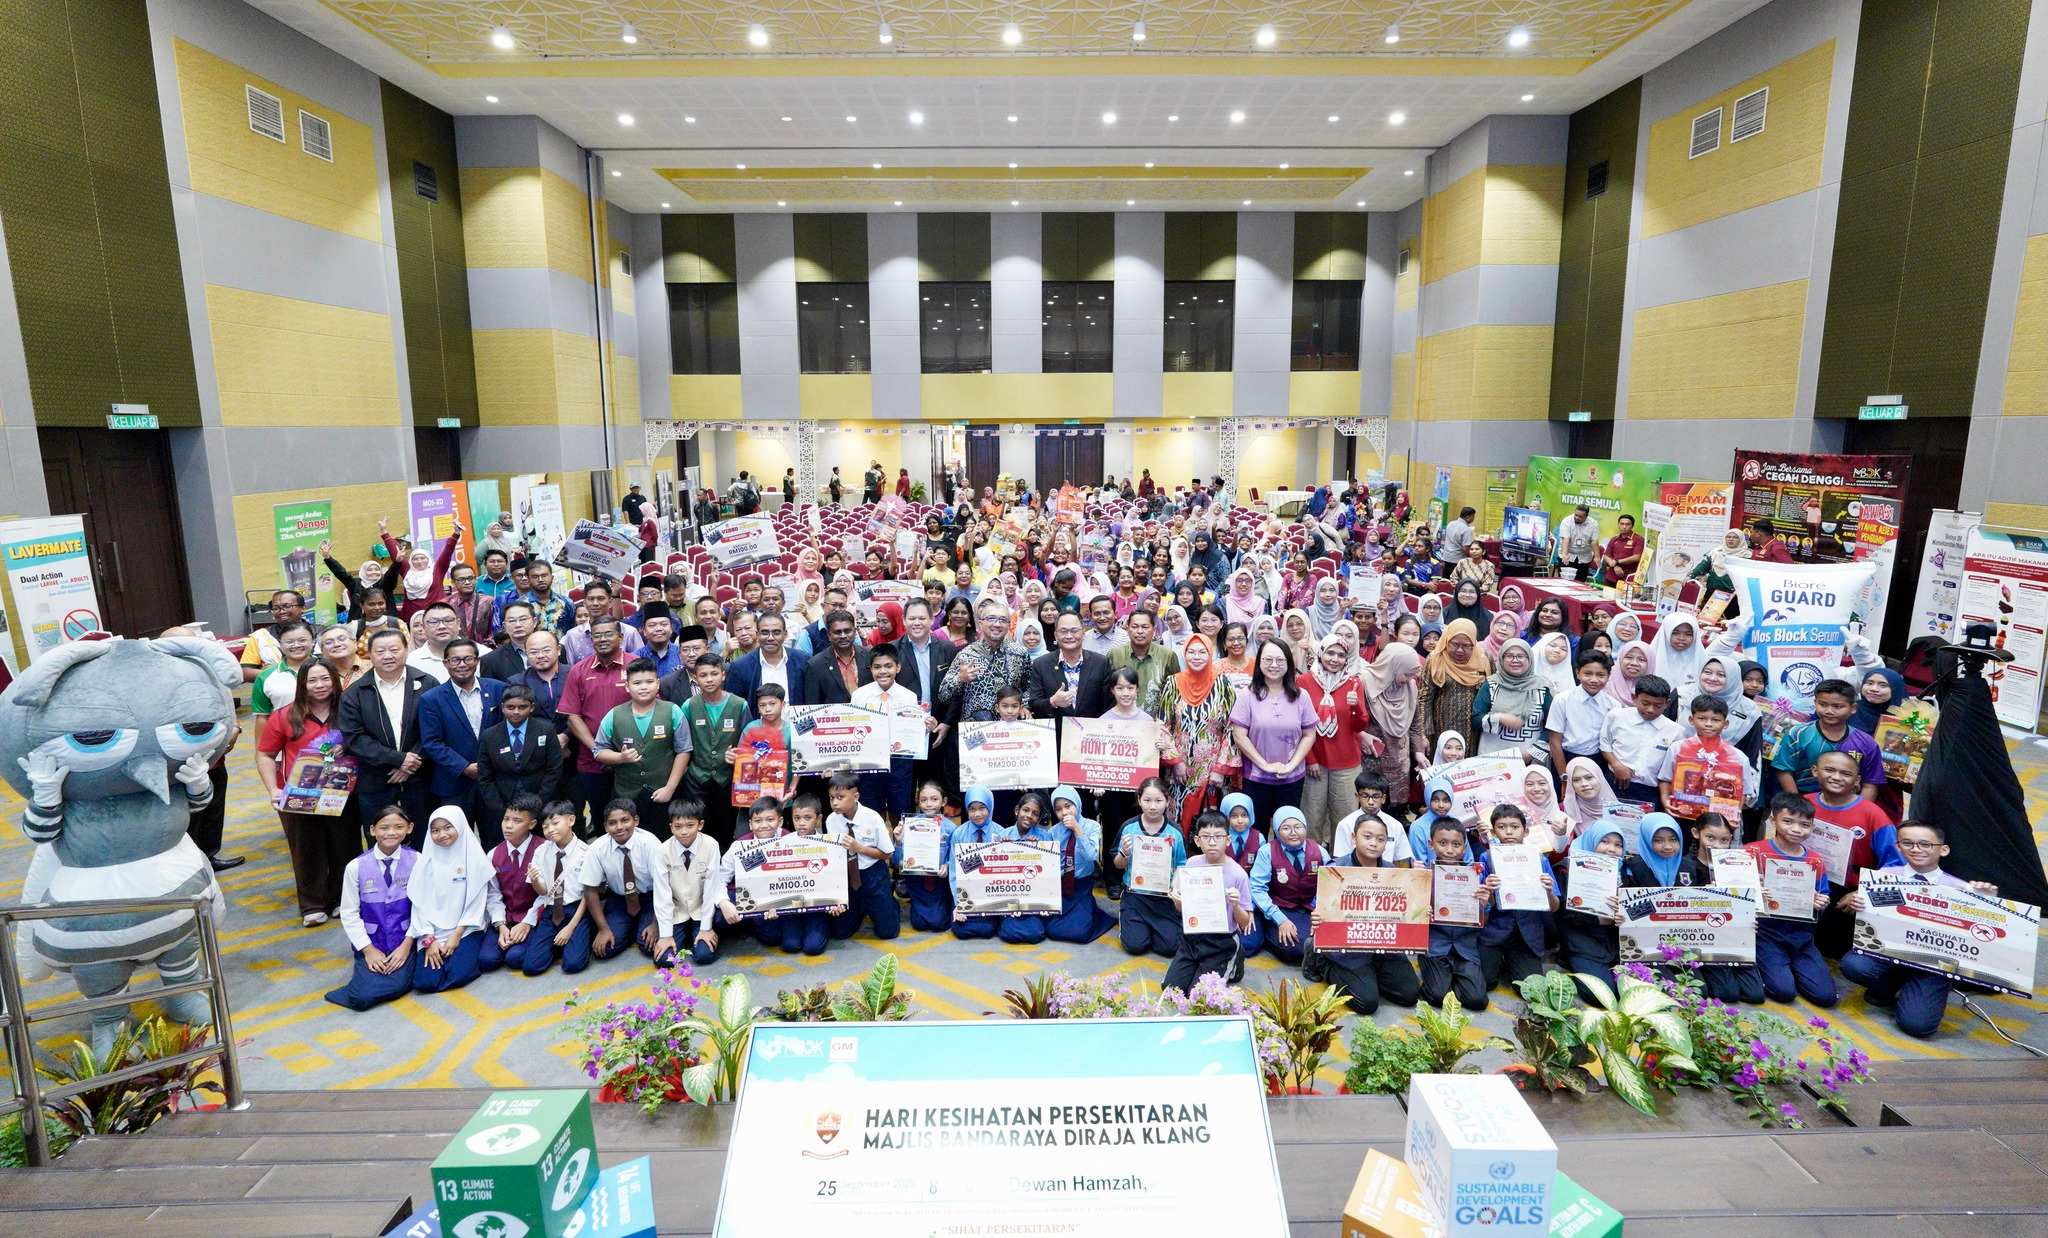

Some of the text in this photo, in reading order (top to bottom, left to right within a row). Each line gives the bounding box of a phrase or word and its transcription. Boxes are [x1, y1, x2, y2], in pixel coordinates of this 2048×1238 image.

[113, 416, 150, 428] KELUAR
[1766, 472, 1799, 483] CEGAH
[1801, 475, 1844, 486] DENGGI
[1561, 494, 1621, 510] KITAR SEMULA
[1665, 493, 1727, 505] DEMAM
[9, 540, 83, 561] LAVERMATE
[20, 571, 64, 585] Dual Action
[1783, 579, 1827, 590] Biore
[1771, 589, 1836, 608] GUARD
[1751, 627, 1840, 644] Mos Block Serum
[816, 716, 841, 724] VIDEO
[818, 745, 862, 754] RM300.00
[1081, 740, 1139, 757] HUNT 2025
[988, 759, 1031, 769] RM200.00
[1087, 770, 1130, 780] RM200.00
[766, 849, 794, 858] VIDEO
[769, 880, 816, 890] RM100.00
[985, 885, 1031, 893] RM500.00
[1340, 895, 1407, 912] HUNT 2025
[1906, 892, 1949, 909] VIDEO
[1347, 923, 1397, 931] JOHAN
[1347, 931, 1397, 940] RM300.00
[1920, 928, 1966, 943] SAGUHATI
[1905, 930, 1980, 956] RM100.00
[483, 1100, 506, 1117] 13
[865, 1103, 1209, 1128] HARI KESIHATAN PERSEKITARAN
[864, 1125, 1211, 1149] MAJLIS BANDARAYA DIRAJA KLANG
[540, 1152, 554, 1183] 13
[437, 1179, 495, 1201] 13 CLIMATE
[817, 1181, 837, 1196] 25
[1008, 1177, 1067, 1193] Dewan
[1073, 1175, 1148, 1193] Hamzah,
[1456, 1184, 1545, 1194] SUSTAINABLE
[463, 1190, 493, 1200] ACTION
[1456, 1195, 1545, 1205] DEVELOPMENT
[1455, 1206, 1543, 1225] GOALS
